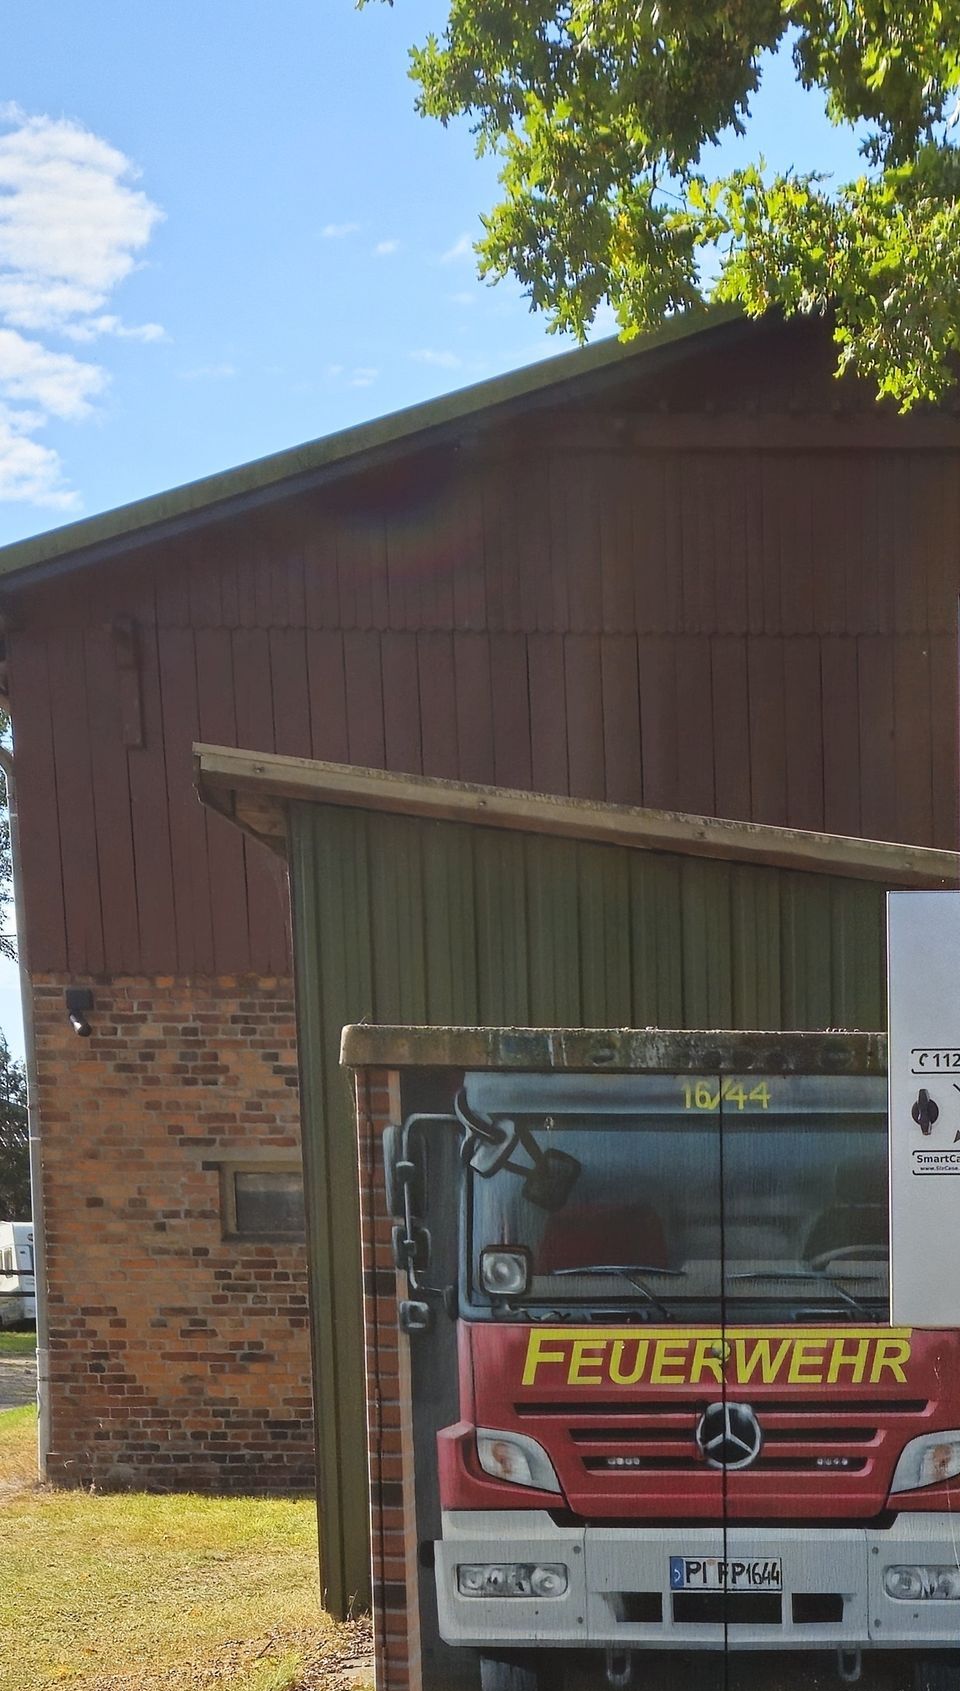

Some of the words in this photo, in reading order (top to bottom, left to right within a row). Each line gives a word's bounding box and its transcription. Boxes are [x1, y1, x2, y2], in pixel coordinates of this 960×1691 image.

[681, 1076, 772, 1110] 16/44
[521, 1328, 913, 1385] FEUERWEHR
[685, 1561, 707, 1584] PI
